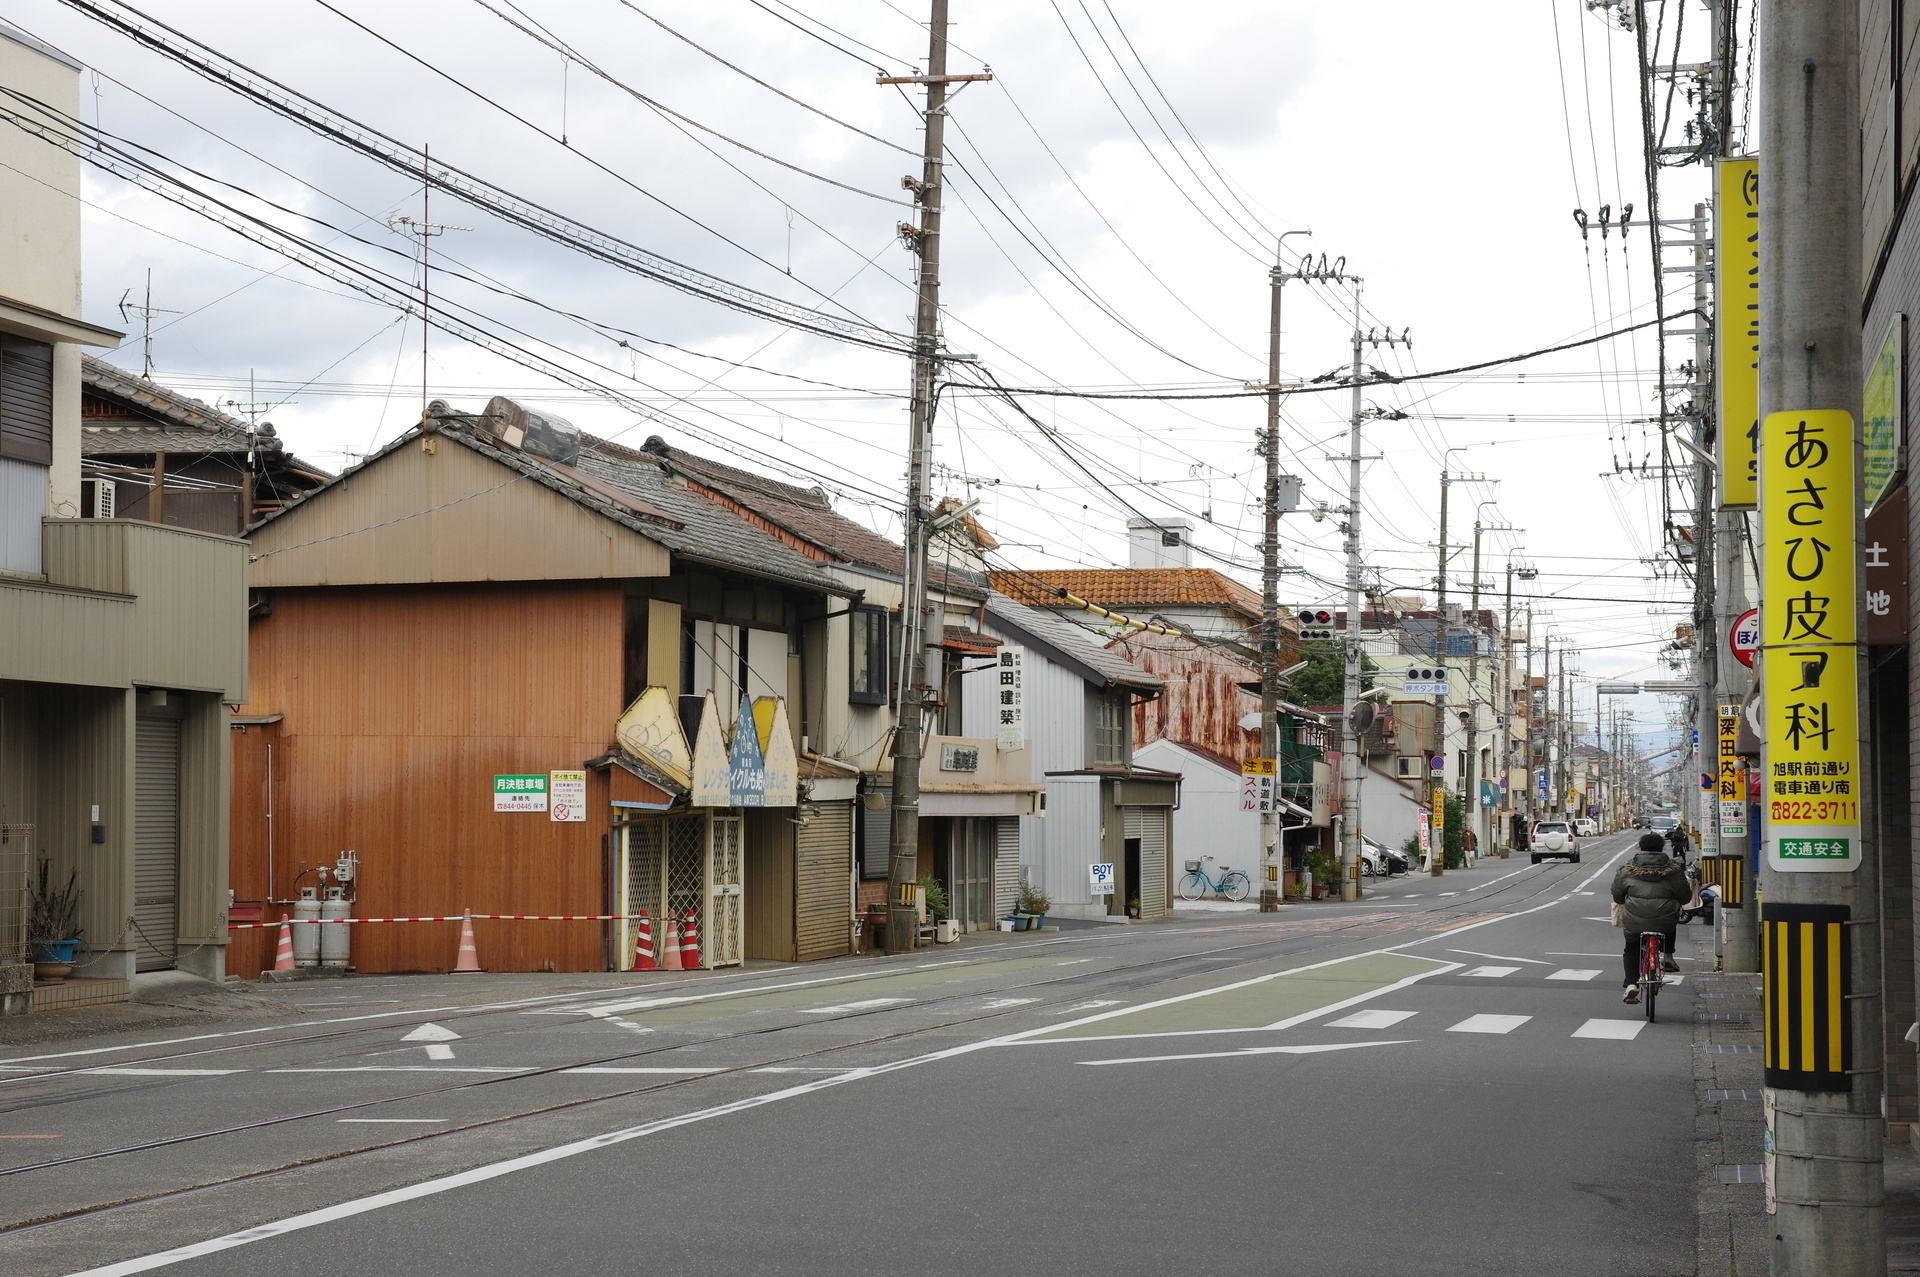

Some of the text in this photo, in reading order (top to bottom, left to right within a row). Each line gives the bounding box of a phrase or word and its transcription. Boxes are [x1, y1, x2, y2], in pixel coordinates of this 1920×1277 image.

[1865, 541, 1890, 616] 土地
[1000, 651, 1014, 725] 島田建築
[1720, 717, 1737, 799] 深田内科
[1244, 760, 1273, 774] 注意
[1774, 761, 1850, 776] 旭駅前通り
[497, 778, 544, 790] 月決駐車場
[1774, 780, 1850, 795] 電車通り南
[1243, 776, 1257, 810] スベル
[1259, 777, 1271, 811] 軌道敷
[1782, 801, 1856, 820] 822-3711
[1784, 841, 1844, 856] 交通安全
[1092, 864, 1113, 875] BOY
[1098, 874, 1106, 883] P
